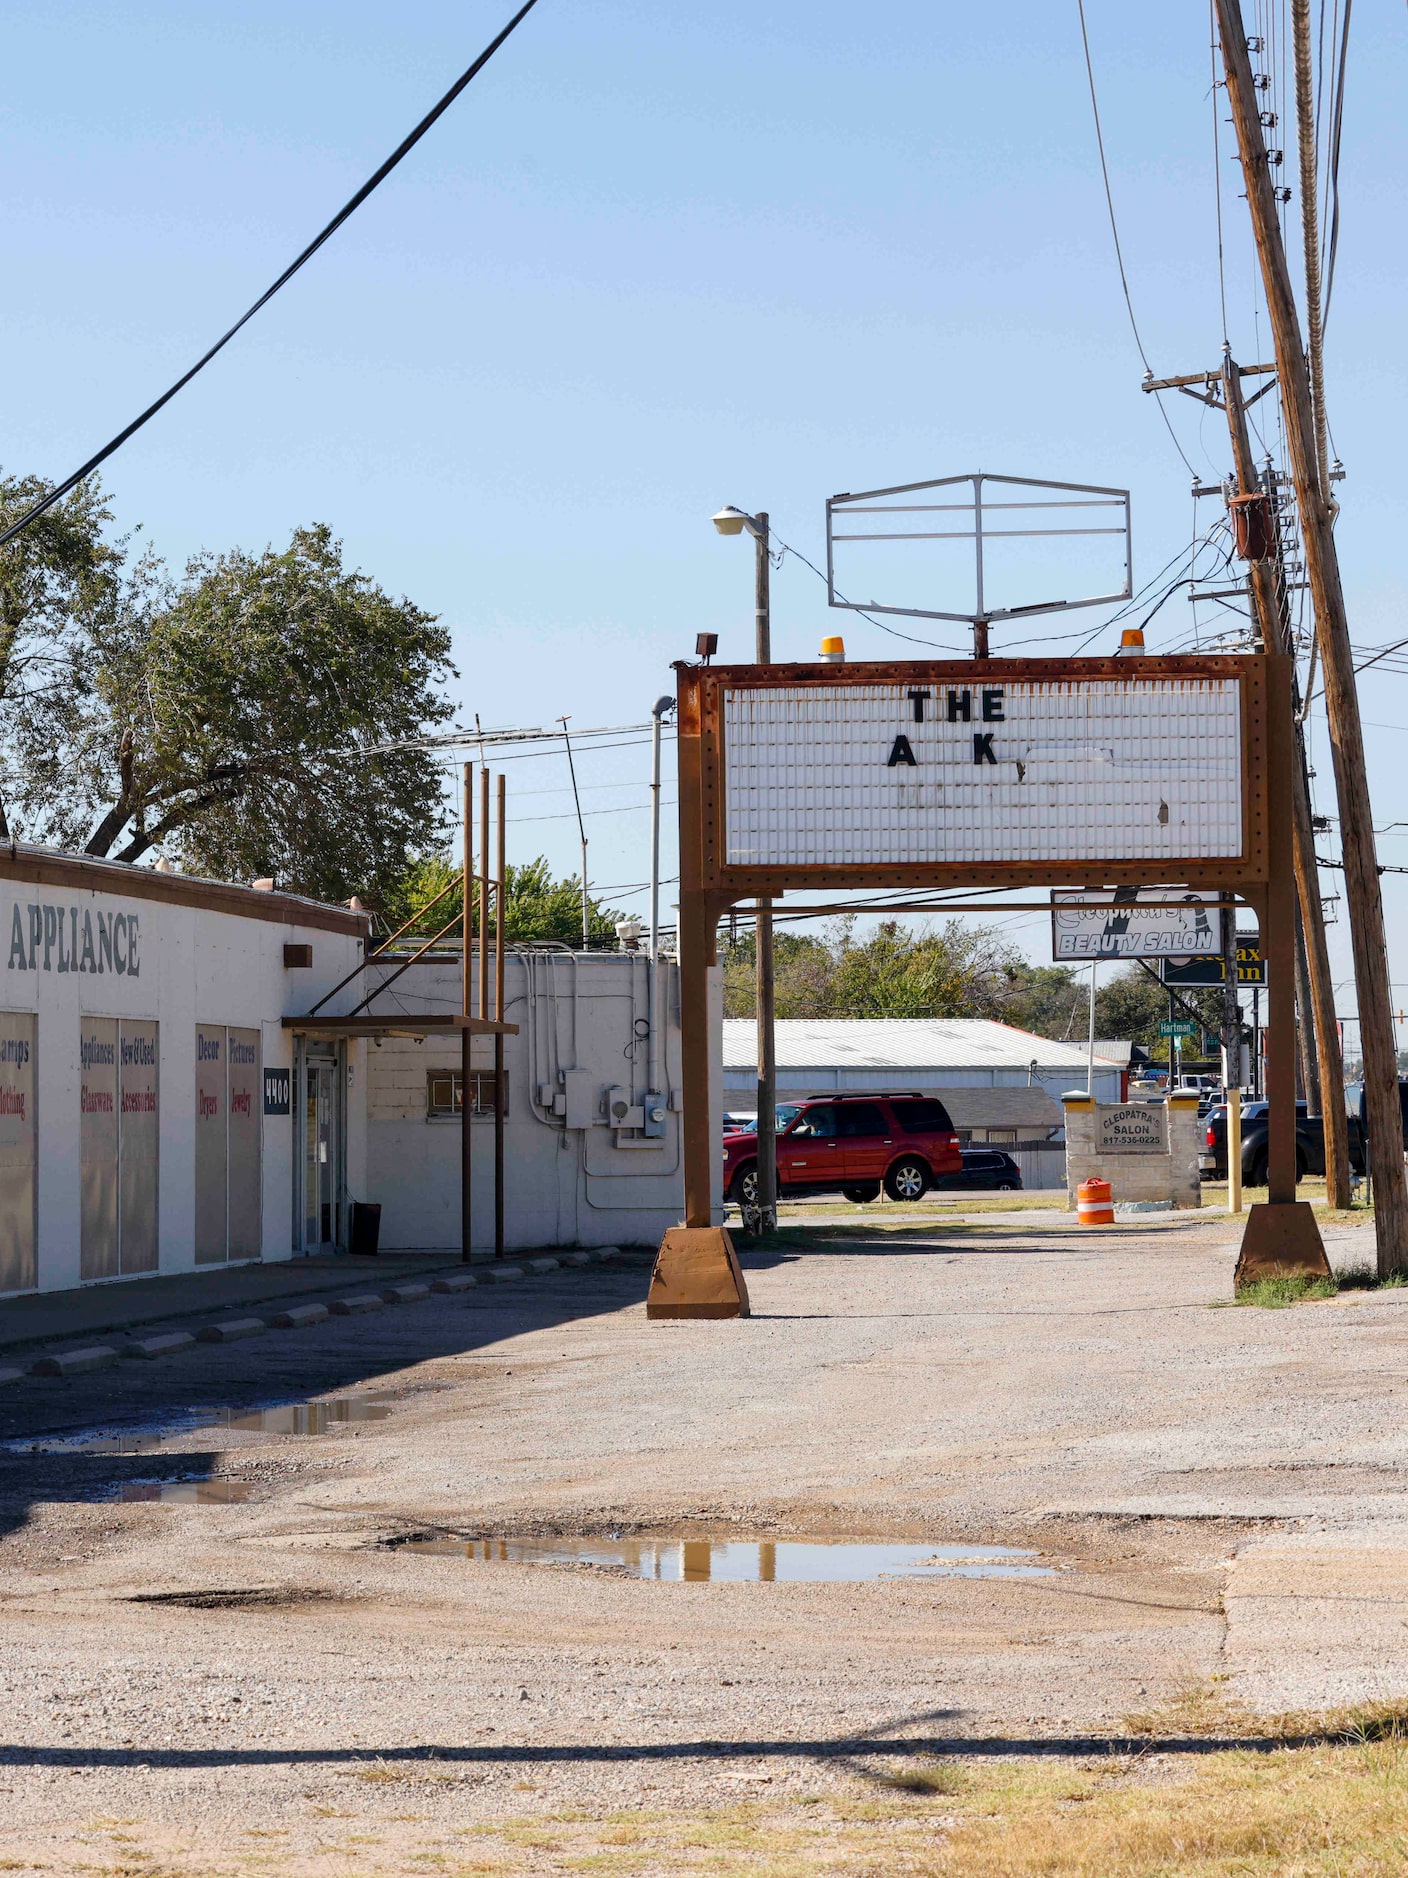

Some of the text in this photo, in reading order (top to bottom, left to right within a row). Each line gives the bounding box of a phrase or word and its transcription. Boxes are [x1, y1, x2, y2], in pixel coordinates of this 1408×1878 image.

[908, 690, 1004, 723] THE
[887, 733, 998, 767] A K
[8, 902, 141, 978] APPLIANCE
[1059, 931, 1213, 953] BEAUTY SALON
[1160, 1022, 1191, 1033] Hartman
[198, 1033, 220, 1061] Decor
[229, 1036, 255, 1065] Pictures
[81, 1084, 113, 1113] Glassware
[121, 1085, 156, 1113] Accessories
[199, 1088, 217, 1120] Dryers
[231, 1087, 252, 1118] Jewelry
[266, 1078, 289, 1105] 4400
[1103, 1110, 1161, 1129] CLEOPATRA'S
[1114, 1125, 1150, 1135] SALON
[1103, 1136, 1161, 1144] 817-536-0225
